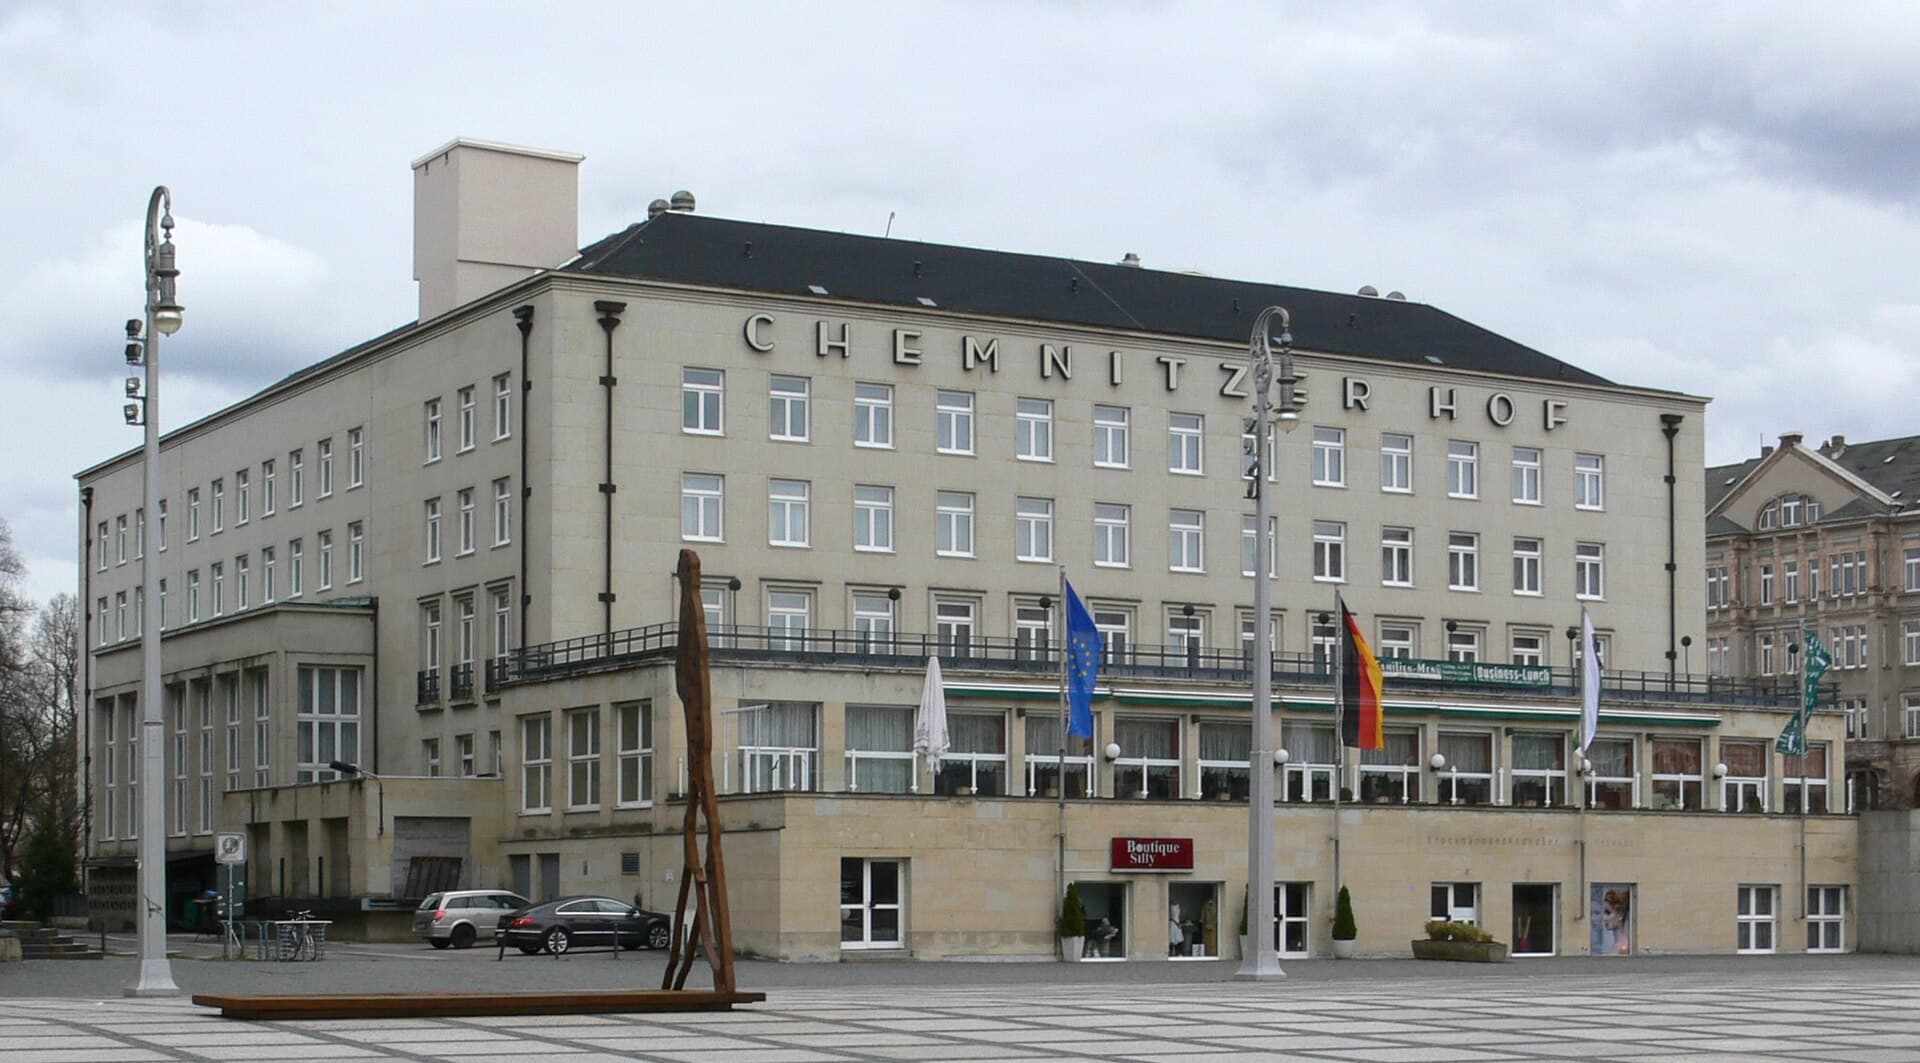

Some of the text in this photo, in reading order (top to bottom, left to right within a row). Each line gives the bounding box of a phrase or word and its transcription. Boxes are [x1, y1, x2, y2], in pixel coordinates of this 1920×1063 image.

[1429, 386, 1569, 431] HOF
[1477, 666, 1550, 682] Business-Lunch
[1127, 840, 1180, 857] Boutique
[1130, 853, 1156, 868] Silly
